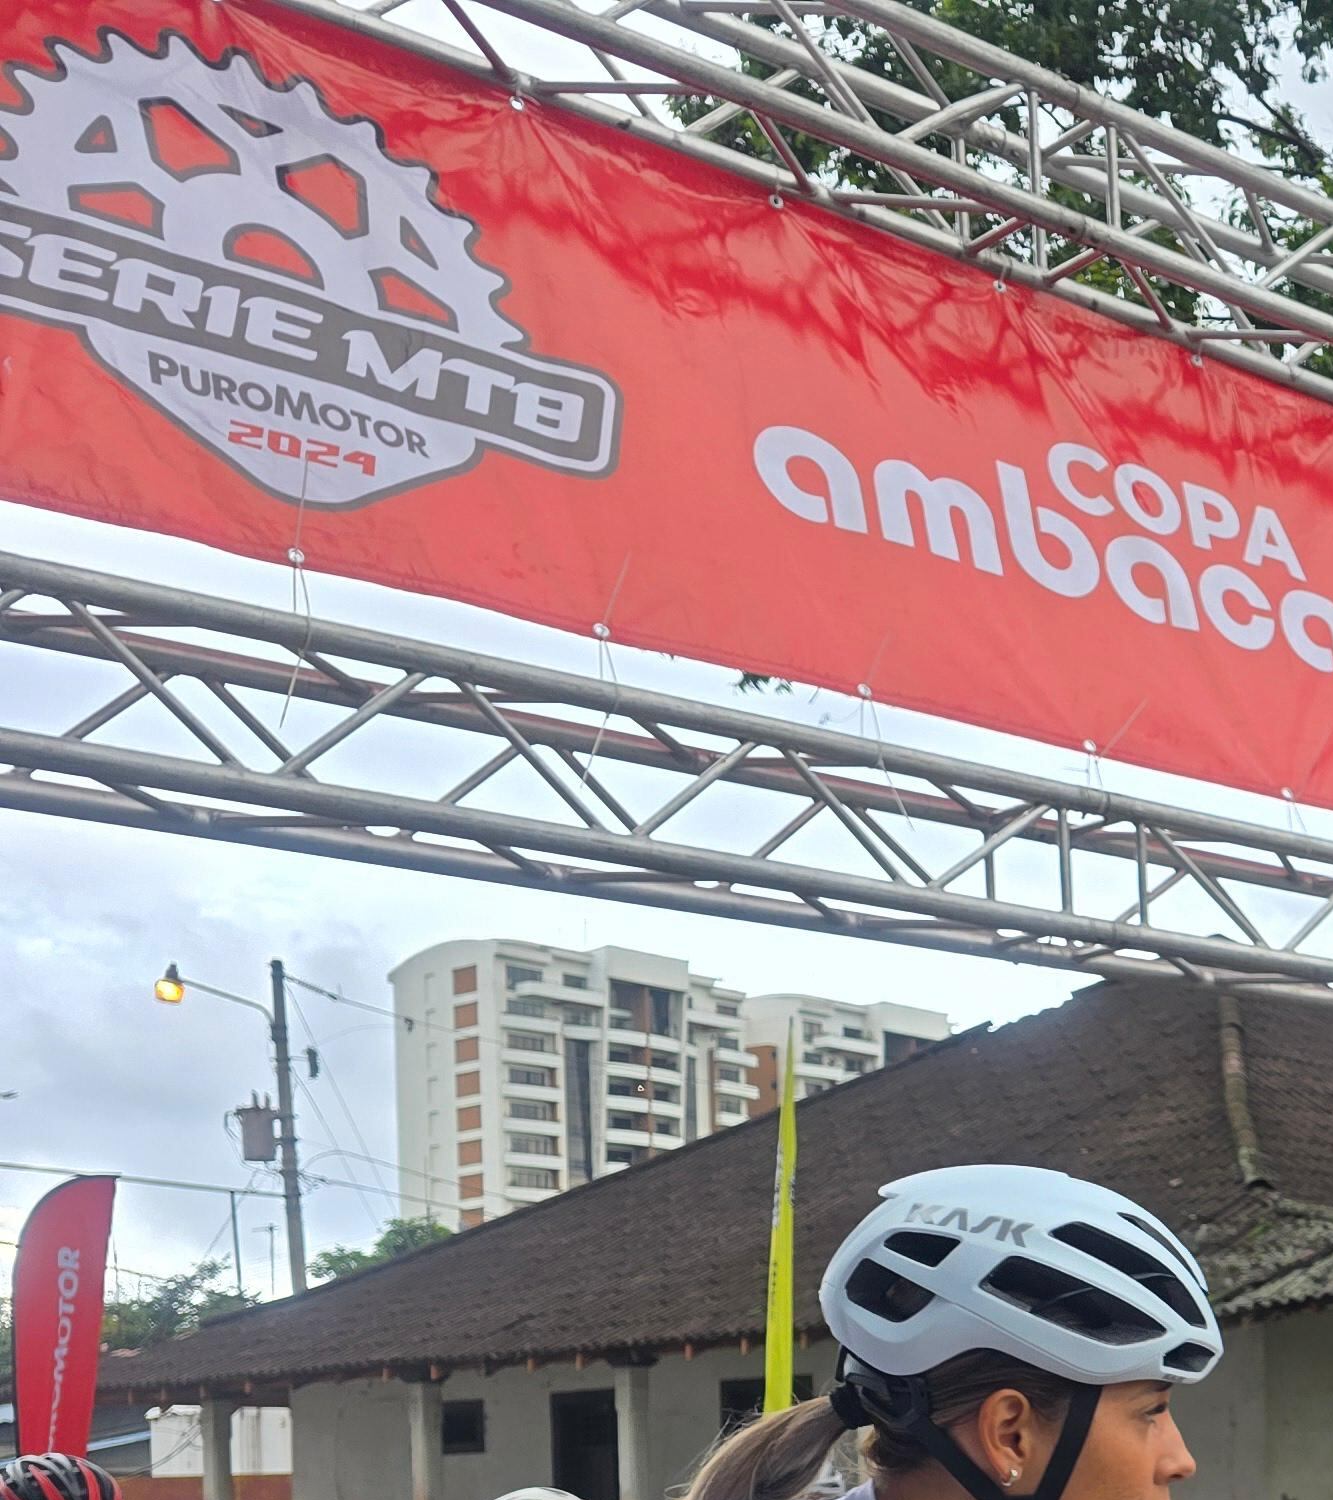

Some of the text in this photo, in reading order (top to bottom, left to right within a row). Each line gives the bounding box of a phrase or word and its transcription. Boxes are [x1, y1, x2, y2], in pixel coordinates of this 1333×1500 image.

[146, 351, 431, 460] PUROMOTOR
[345, 328, 586, 443] MTB
[228, 420, 378, 478] 2024
[1047, 441, 1306, 582] COPA
[904, 1203, 1034, 1248] KASK
